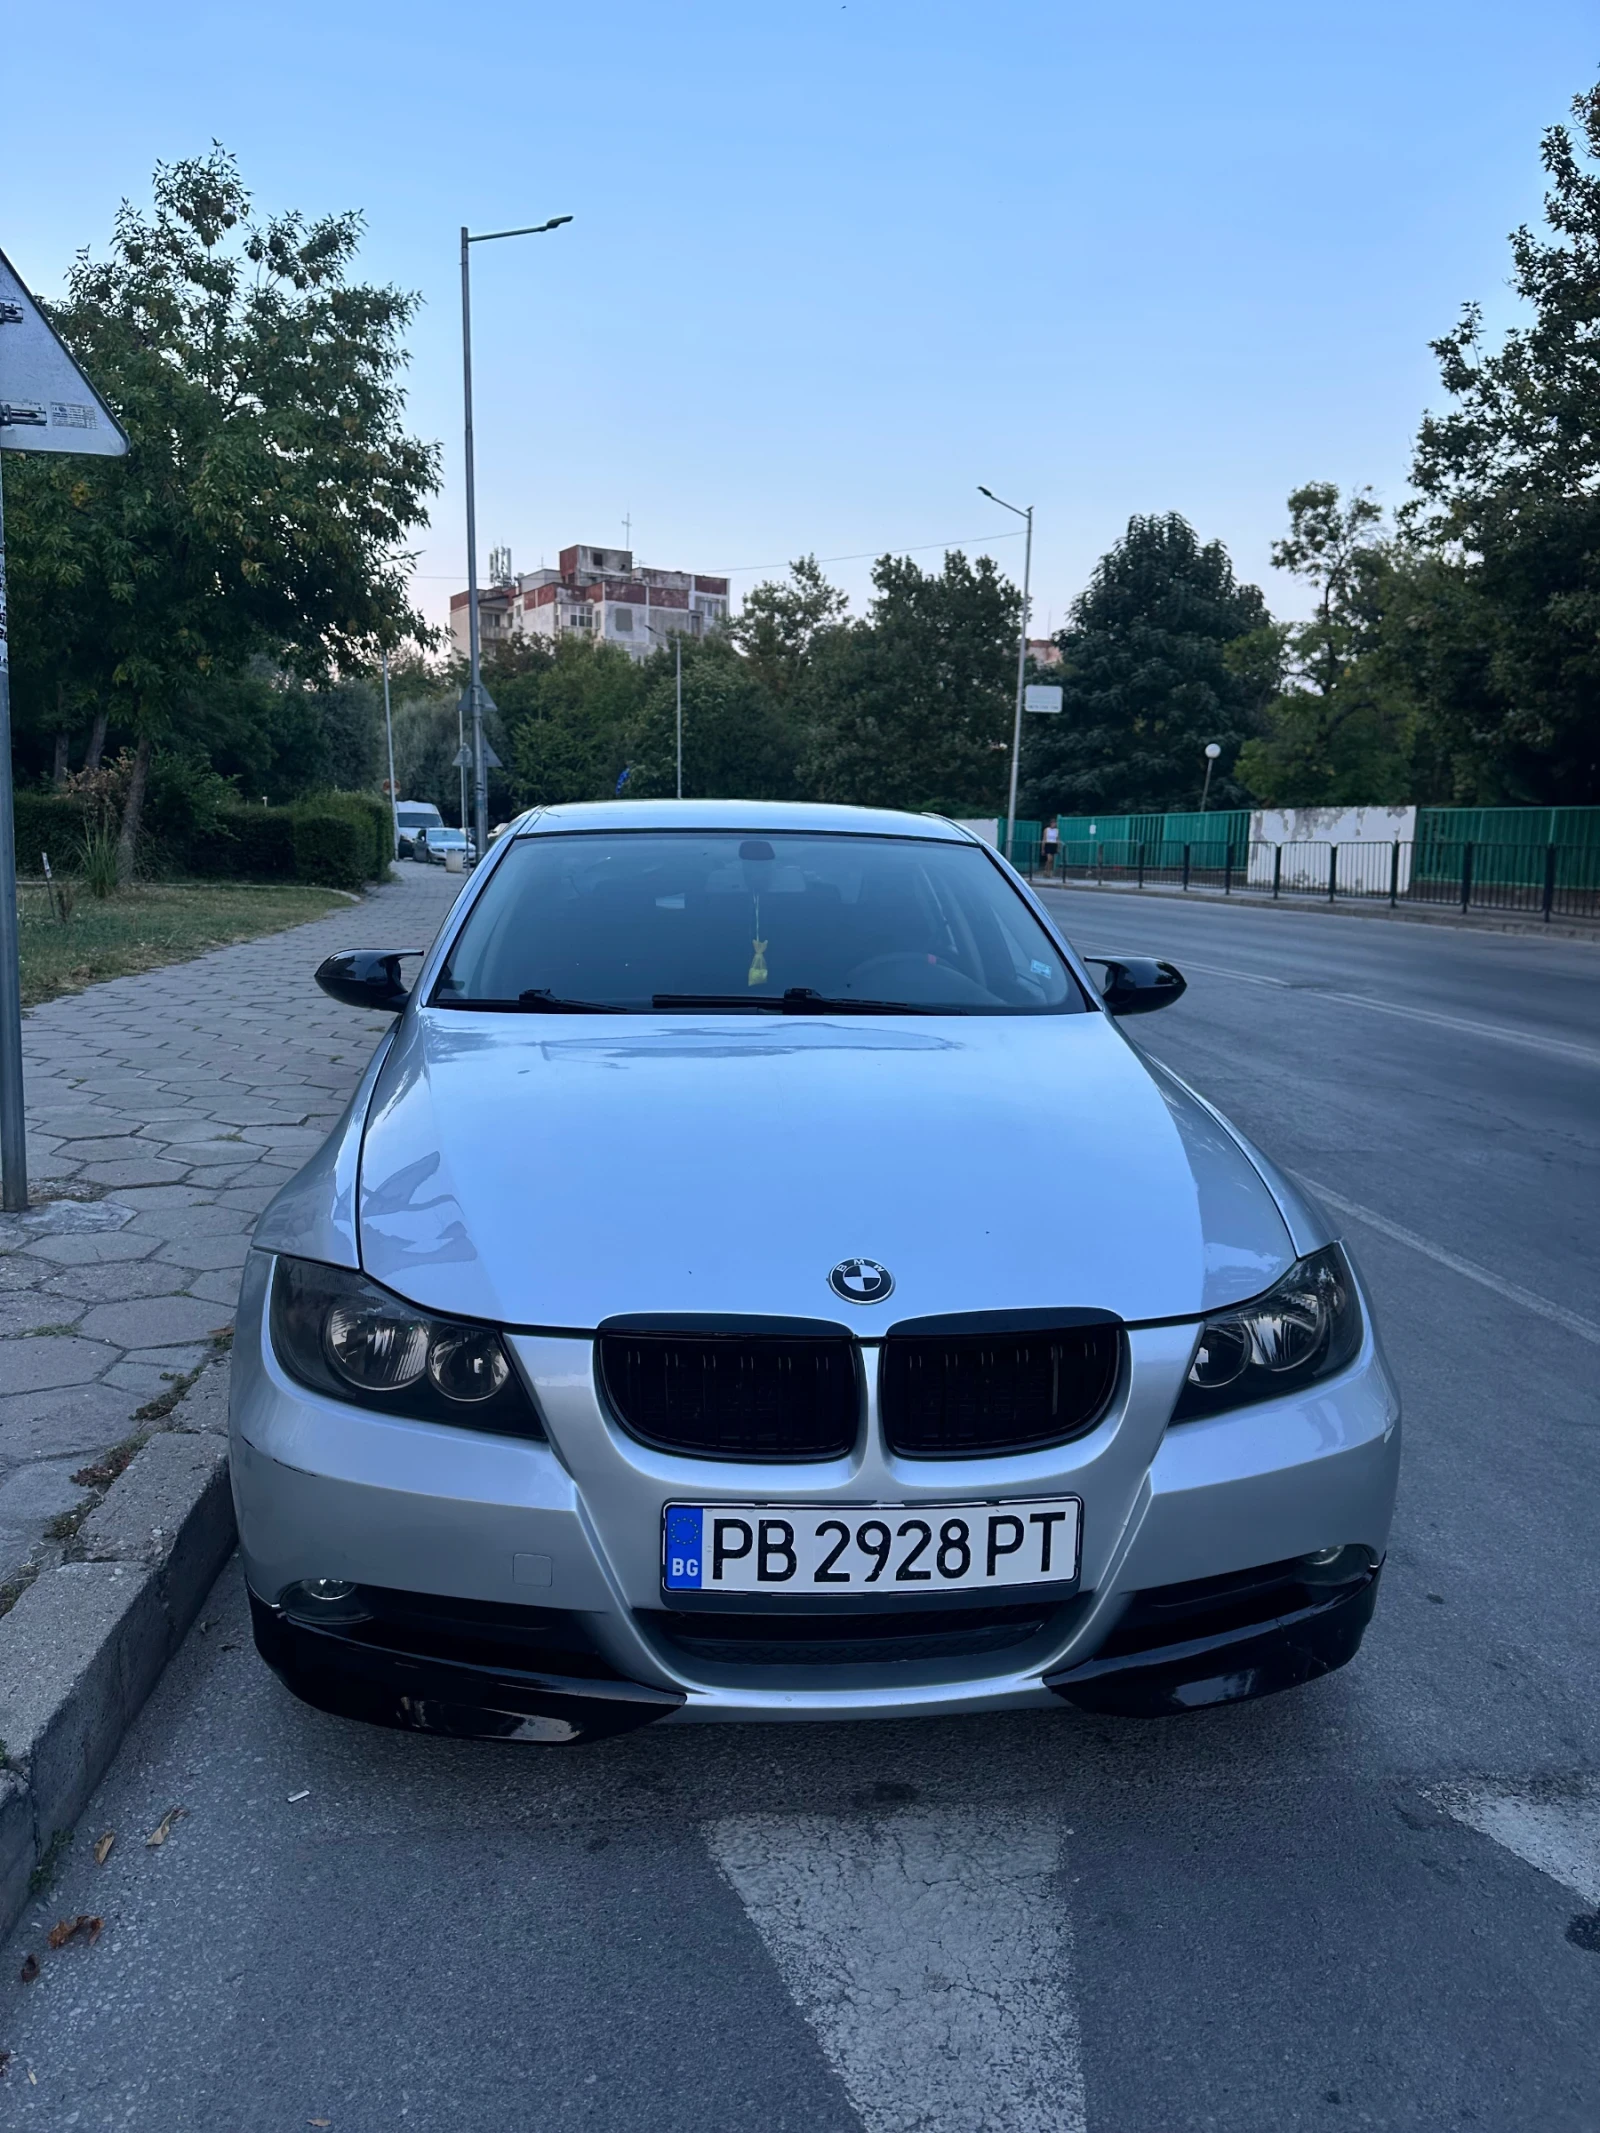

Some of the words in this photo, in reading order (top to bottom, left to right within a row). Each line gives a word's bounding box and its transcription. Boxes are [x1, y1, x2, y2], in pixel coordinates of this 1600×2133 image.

[836, 1259, 885, 1272] BMW
[712, 1518, 798, 1582] PB
[813, 1518, 971, 1583] 2928
[986, 1511, 1066, 1577] PT
[672, 1557, 699, 1577] BG
